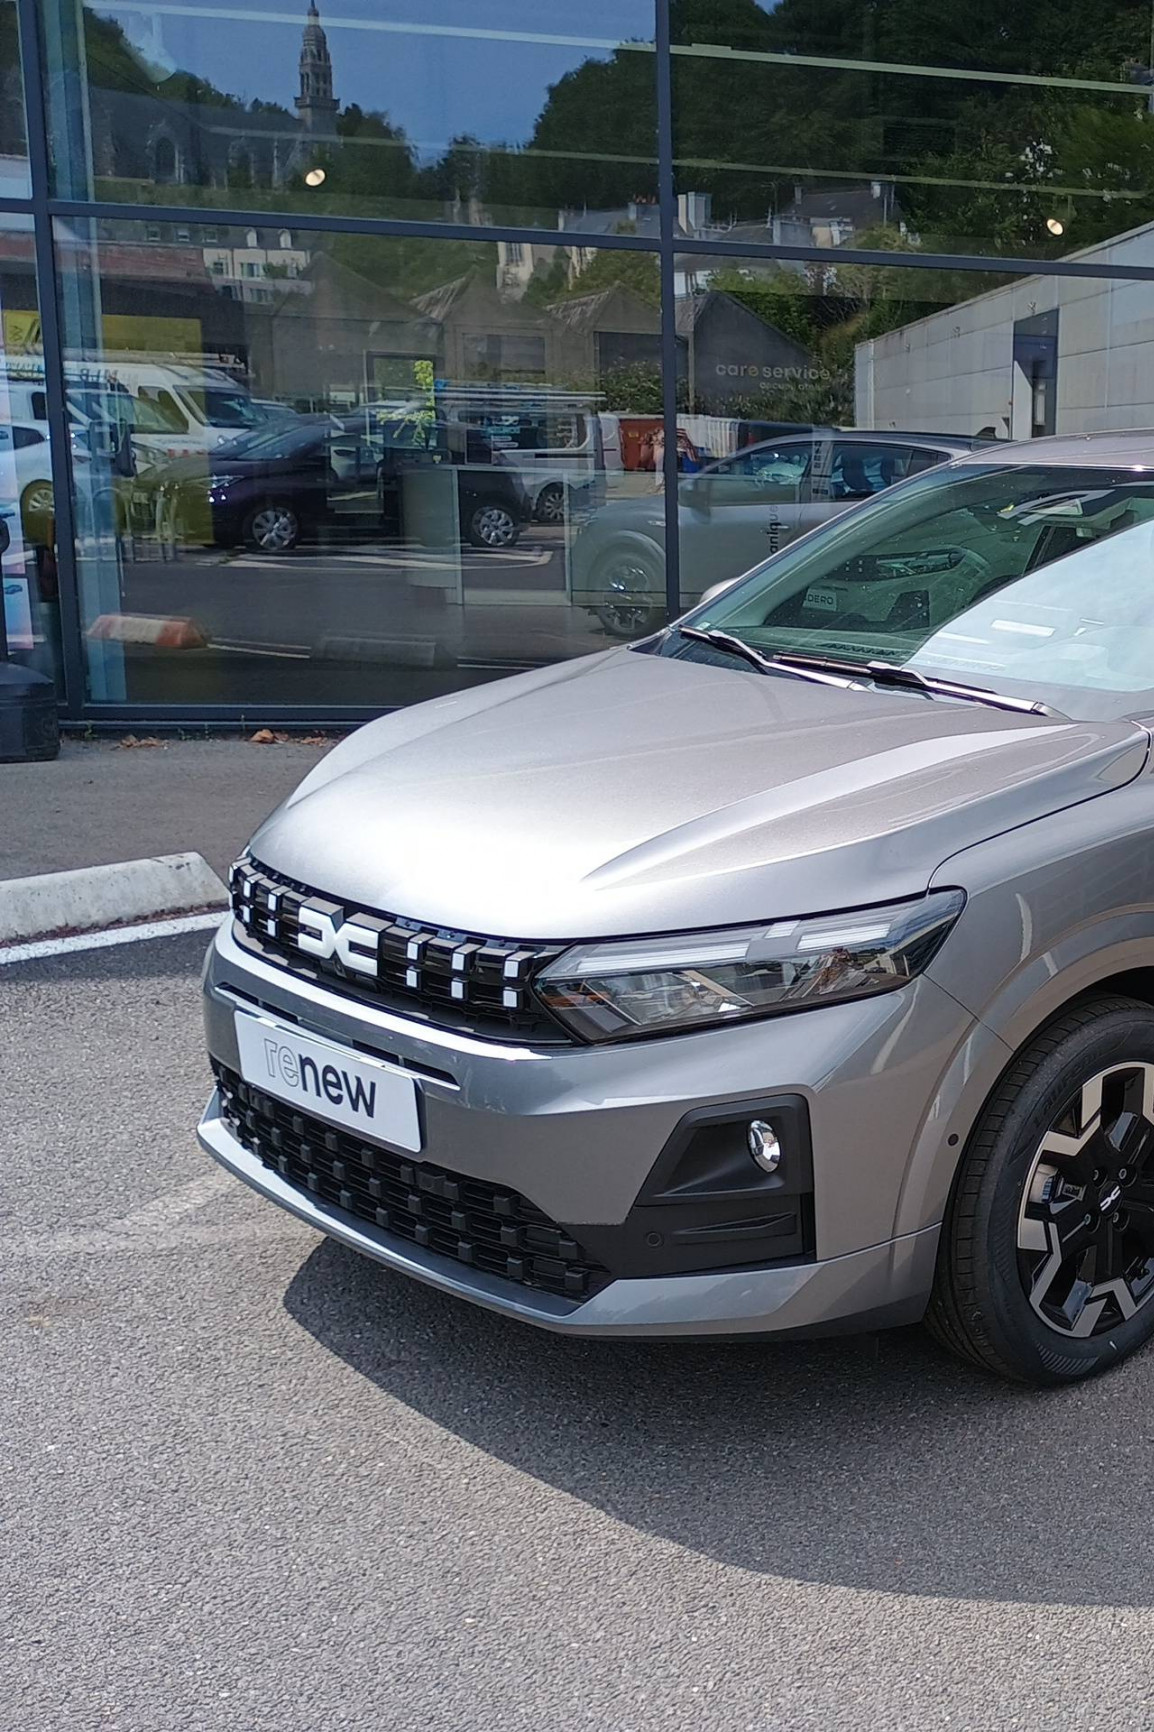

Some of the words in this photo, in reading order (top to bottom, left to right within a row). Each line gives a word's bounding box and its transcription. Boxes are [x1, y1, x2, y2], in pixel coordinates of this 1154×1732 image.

[715, 363, 759, 377] care
[763, 364, 831, 381] service
[805, 593, 834, 605] DERO
[263, 1037, 377, 1119] renew
